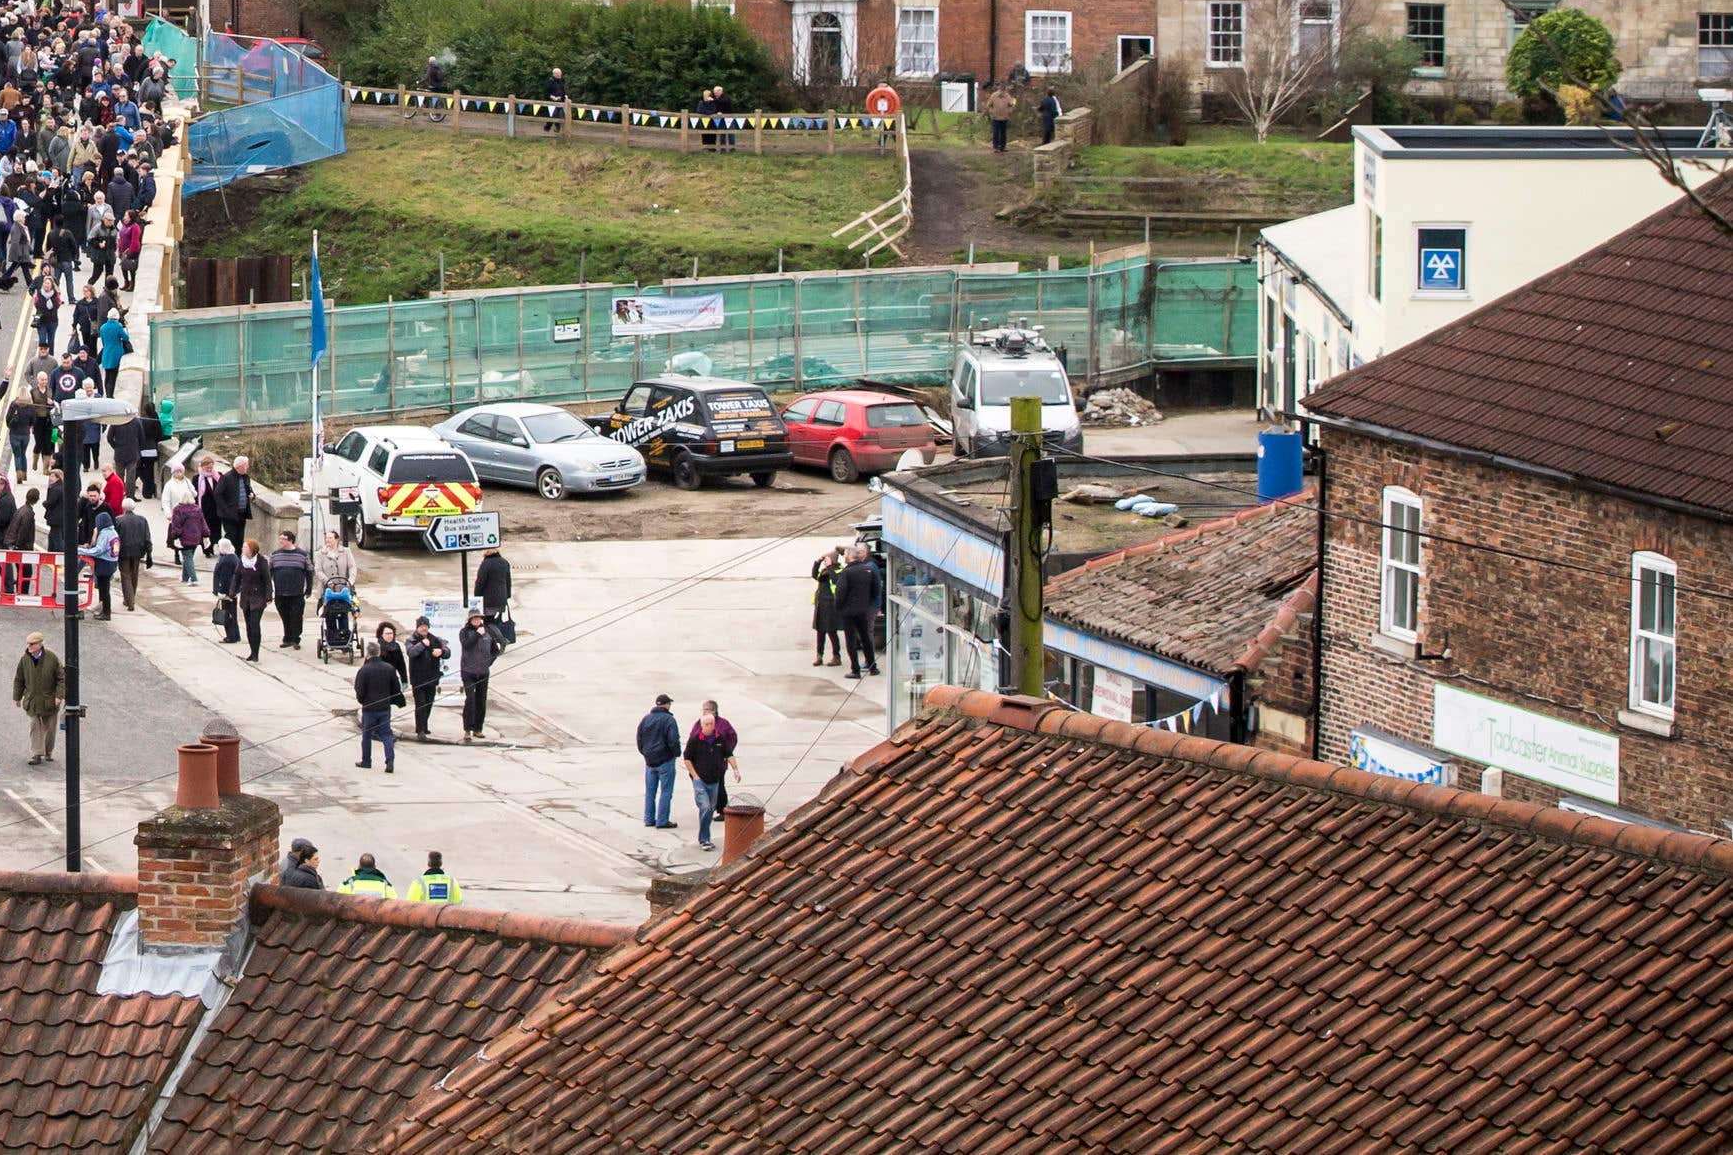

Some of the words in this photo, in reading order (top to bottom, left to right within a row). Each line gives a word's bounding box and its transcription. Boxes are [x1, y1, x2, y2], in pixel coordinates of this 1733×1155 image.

[657, 396, 695, 427] TAXIS
[708, 401, 742, 411] TOWER
[742, 399, 769, 408] TAXIS
[609, 416, 656, 444] TOWER
[1487, 716, 1548, 764] Tadcaster
[1548, 747, 1578, 767] Animal
[1579, 752, 1616, 781] Supplies
